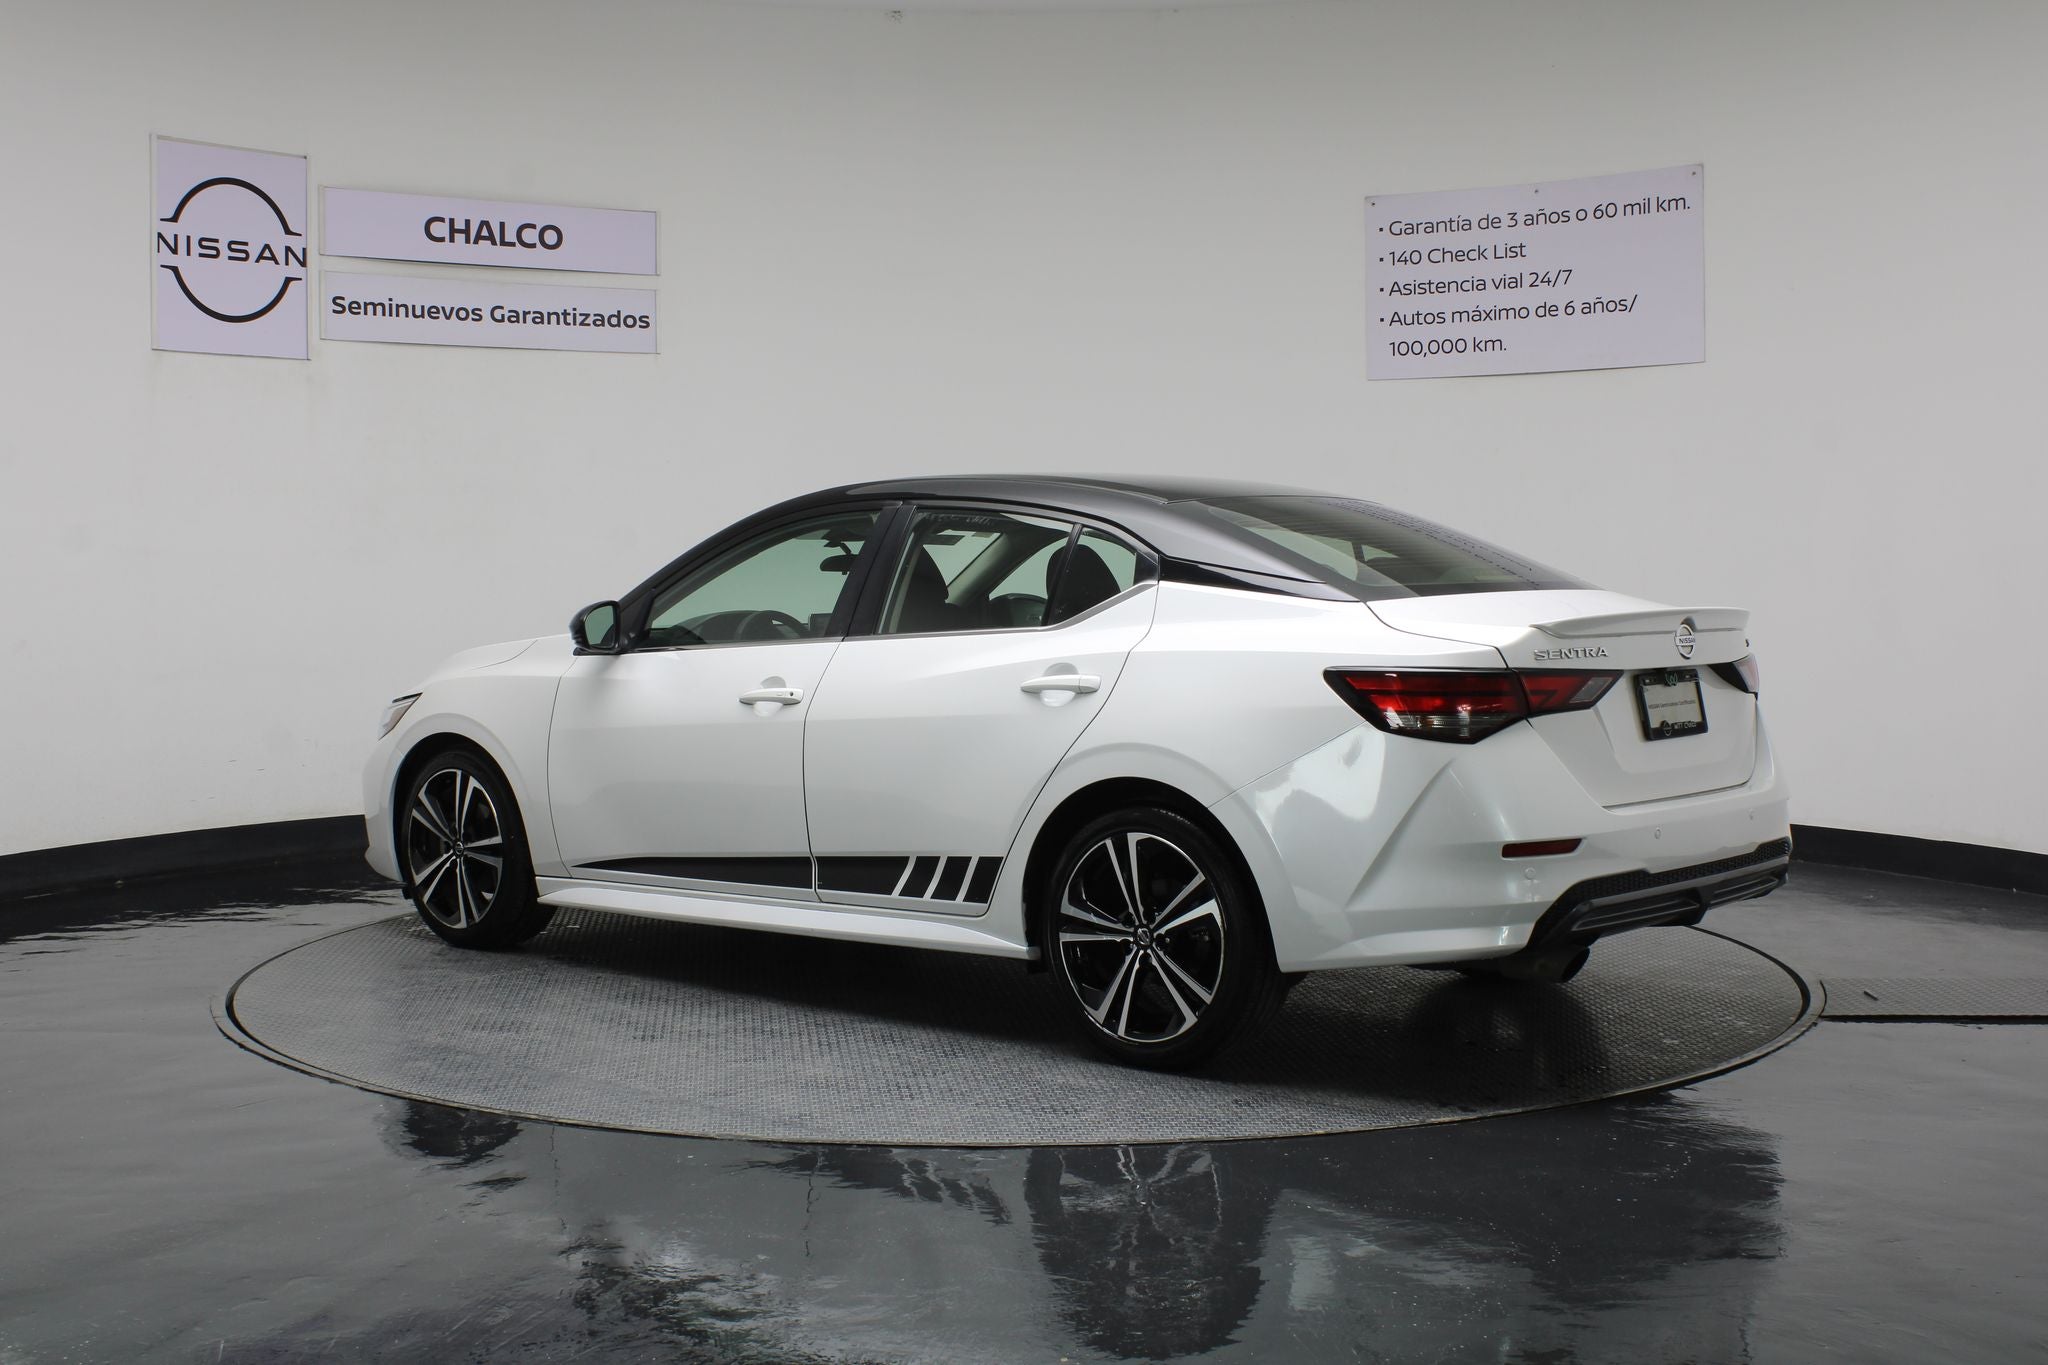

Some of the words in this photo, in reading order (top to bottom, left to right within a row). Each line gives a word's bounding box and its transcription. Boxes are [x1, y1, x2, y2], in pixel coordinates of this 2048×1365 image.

[1389, 214, 1472, 237] Garantía
[1478, 213, 1502, 231] de
[1506, 211, 1518, 228] 3
[1523, 208, 1571, 227] años
[1575, 208, 1588, 222] o
[1592, 202, 1618, 220] 60
[1623, 197, 1651, 217] mil
[1656, 195, 1691, 213] km.
[157, 231, 307, 268] NISSAN
[424, 216, 564, 251] CHALCO
[1389, 249, 1423, 267] 140
[1427, 244, 1489, 264] Check
[1493, 242, 1527, 260] List
[1389, 275, 1487, 297] Asistencia
[1491, 273, 1523, 290] vial
[1528, 268, 1573, 288] 24/7
[331, 295, 483, 323] Seminuevos
[489, 305, 651, 330] Garantizados
[1389, 310, 1446, 327] Autos
[1451, 304, 1530, 324] máximo
[1534, 301, 1559, 319] de
[1564, 299, 1576, 316] 6
[1580, 294, 1638, 315] años/
[1389, 338, 1468, 358] 100,000
[1472, 336, 1508, 353] km.
[1534, 647, 1609, 661] SENTRA
